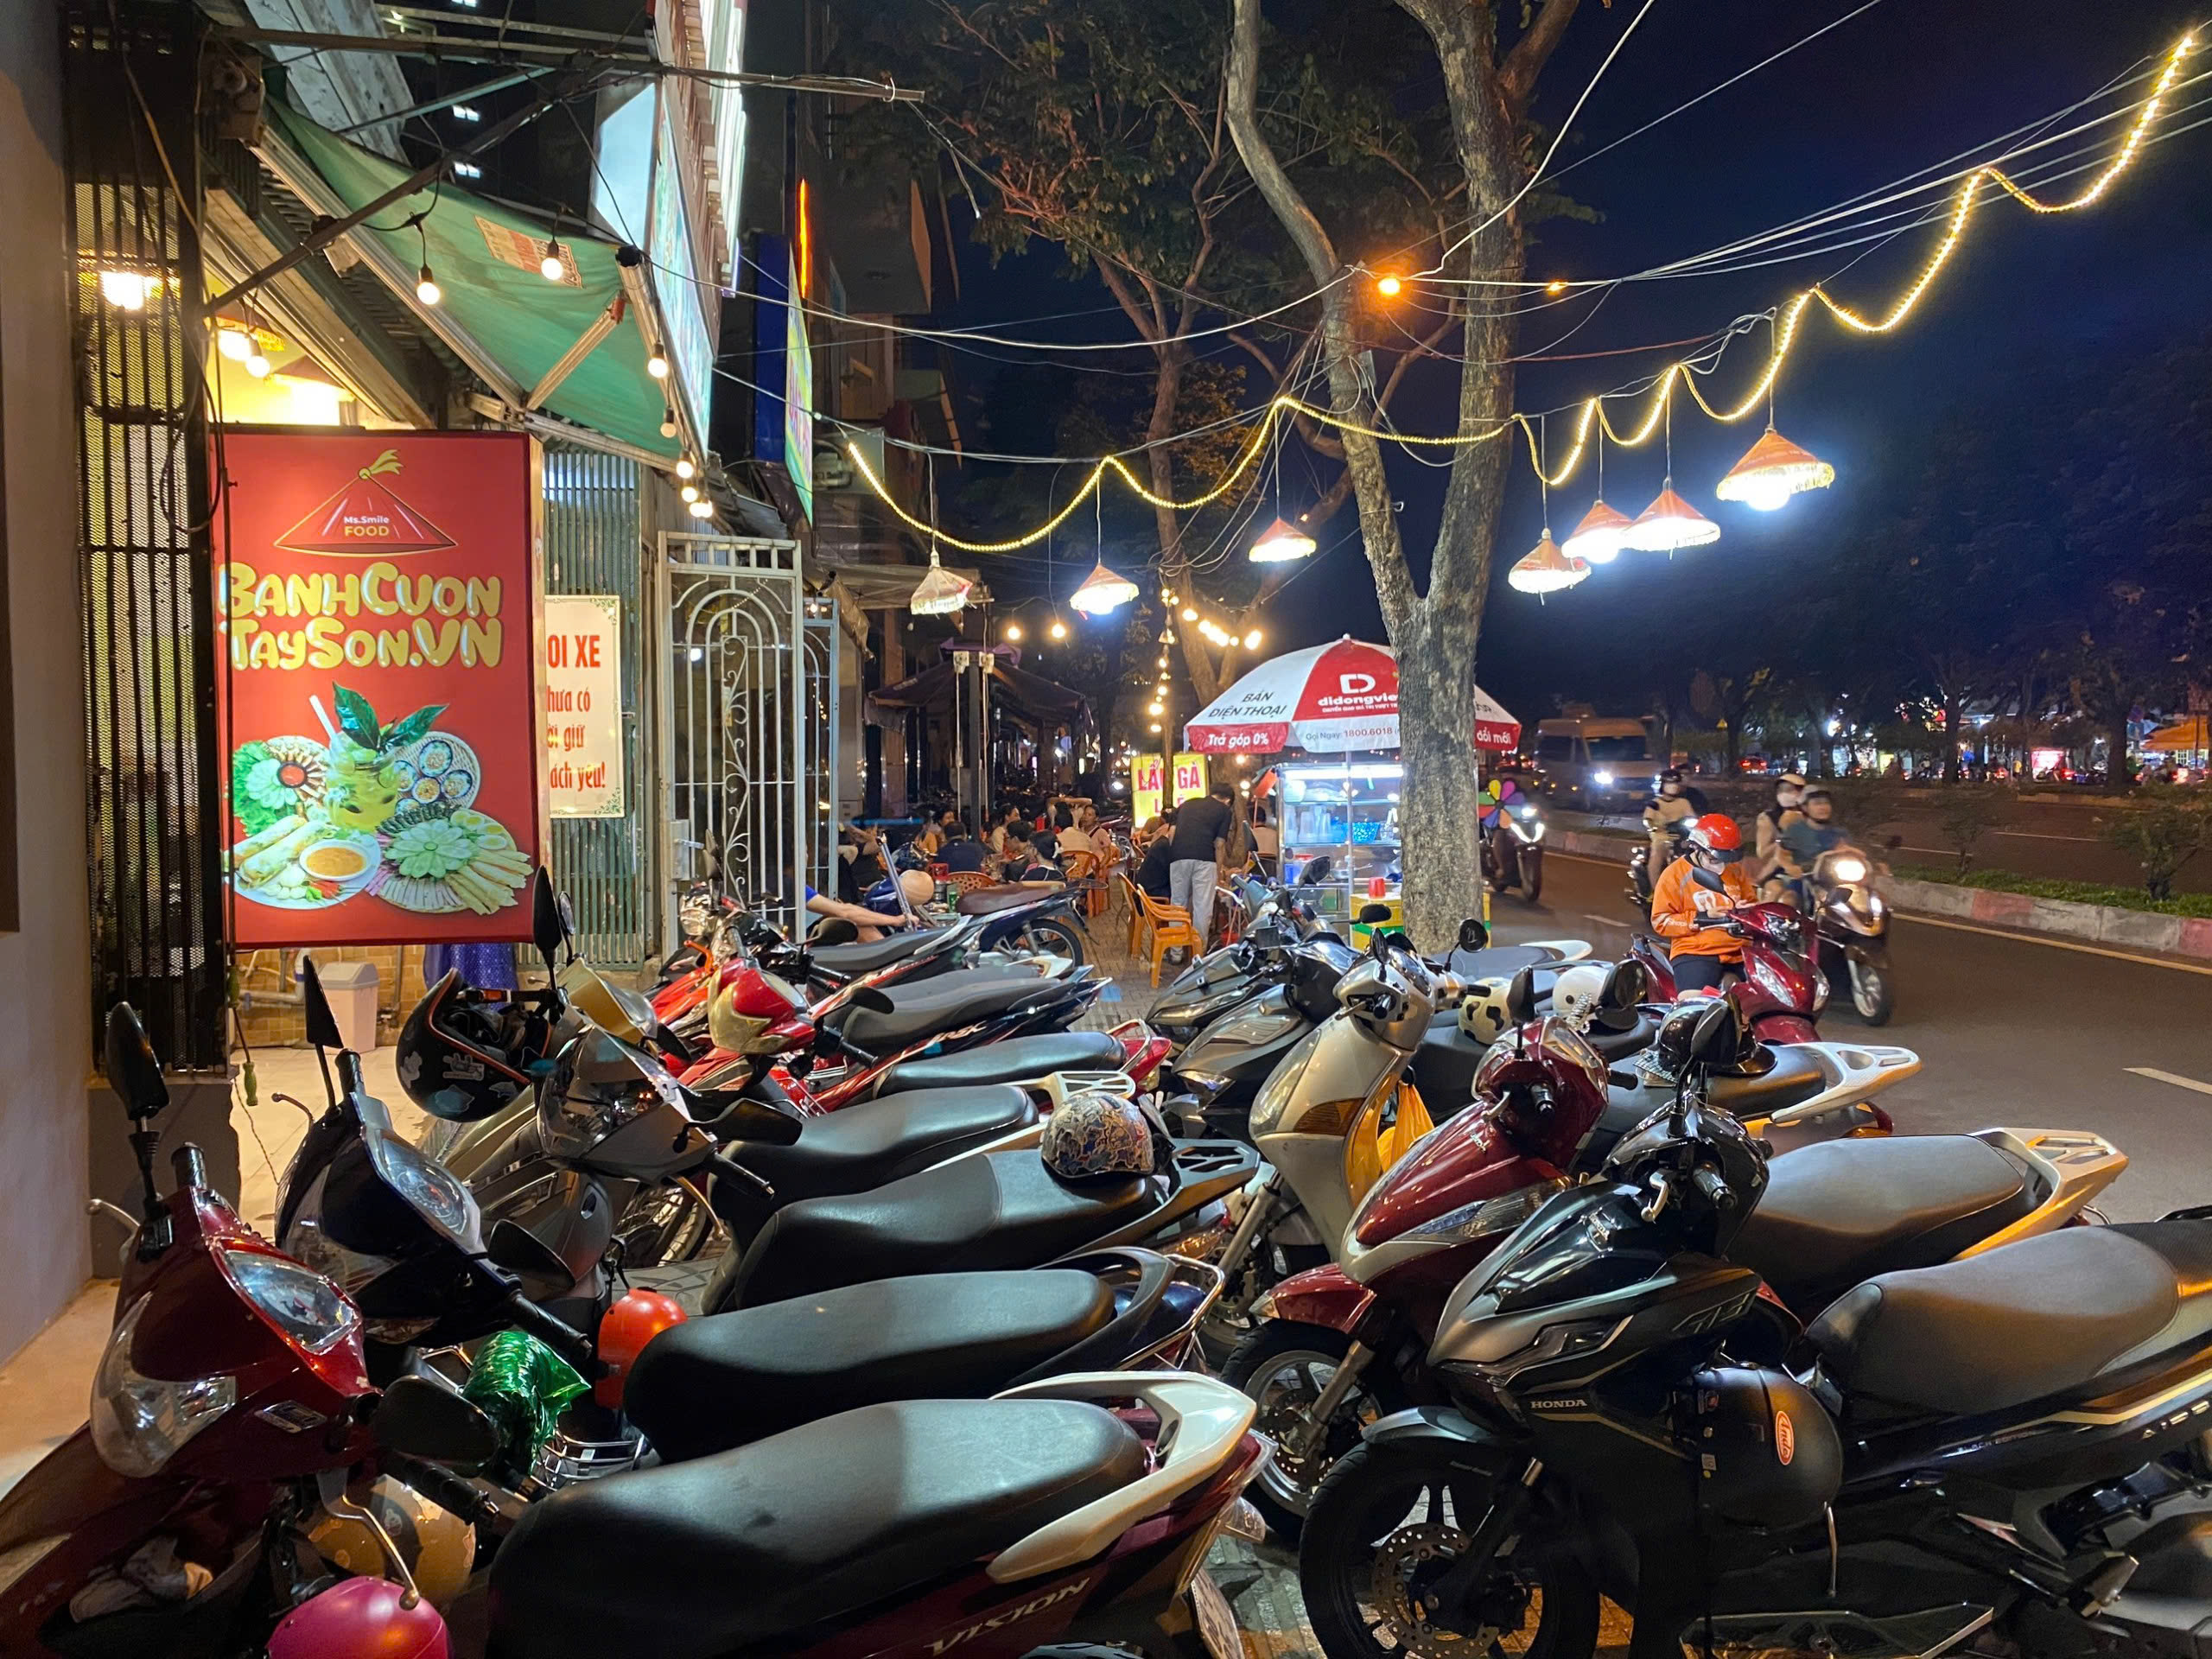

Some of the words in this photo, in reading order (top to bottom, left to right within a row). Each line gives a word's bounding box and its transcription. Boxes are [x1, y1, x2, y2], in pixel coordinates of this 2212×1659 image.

[344, 515, 390, 524] Ms.Smile
[344, 525, 390, 537] FOOD
[547, 634, 568, 668] OI
[575, 634, 601, 668] XE
[547, 685, 572, 712] hưa
[577, 687, 591, 712] có
[1242, 690, 1274, 702] BÁN
[1318, 693, 1399, 705] didongvie
[1208, 705, 1243, 720] ĐIỆN
[1243, 705, 1287, 718] THOẠI
[547, 723, 559, 748] ời
[563, 724, 586, 752] giữ
[1344, 728, 1393, 737] 1800.6018
[1477, 727, 1491, 742] đổi
[1493, 731, 1512, 744] mới
[1208, 733, 1226, 746] Trả
[1228, 733, 1250, 748] góp
[1253, 733, 1269, 746] 0%
[550, 761, 573, 788] ách
[1178, 761, 1201, 789] GÀ
[1530, 1399, 1588, 1409] HONDA
[924, 1577, 1090, 1656] VISION
